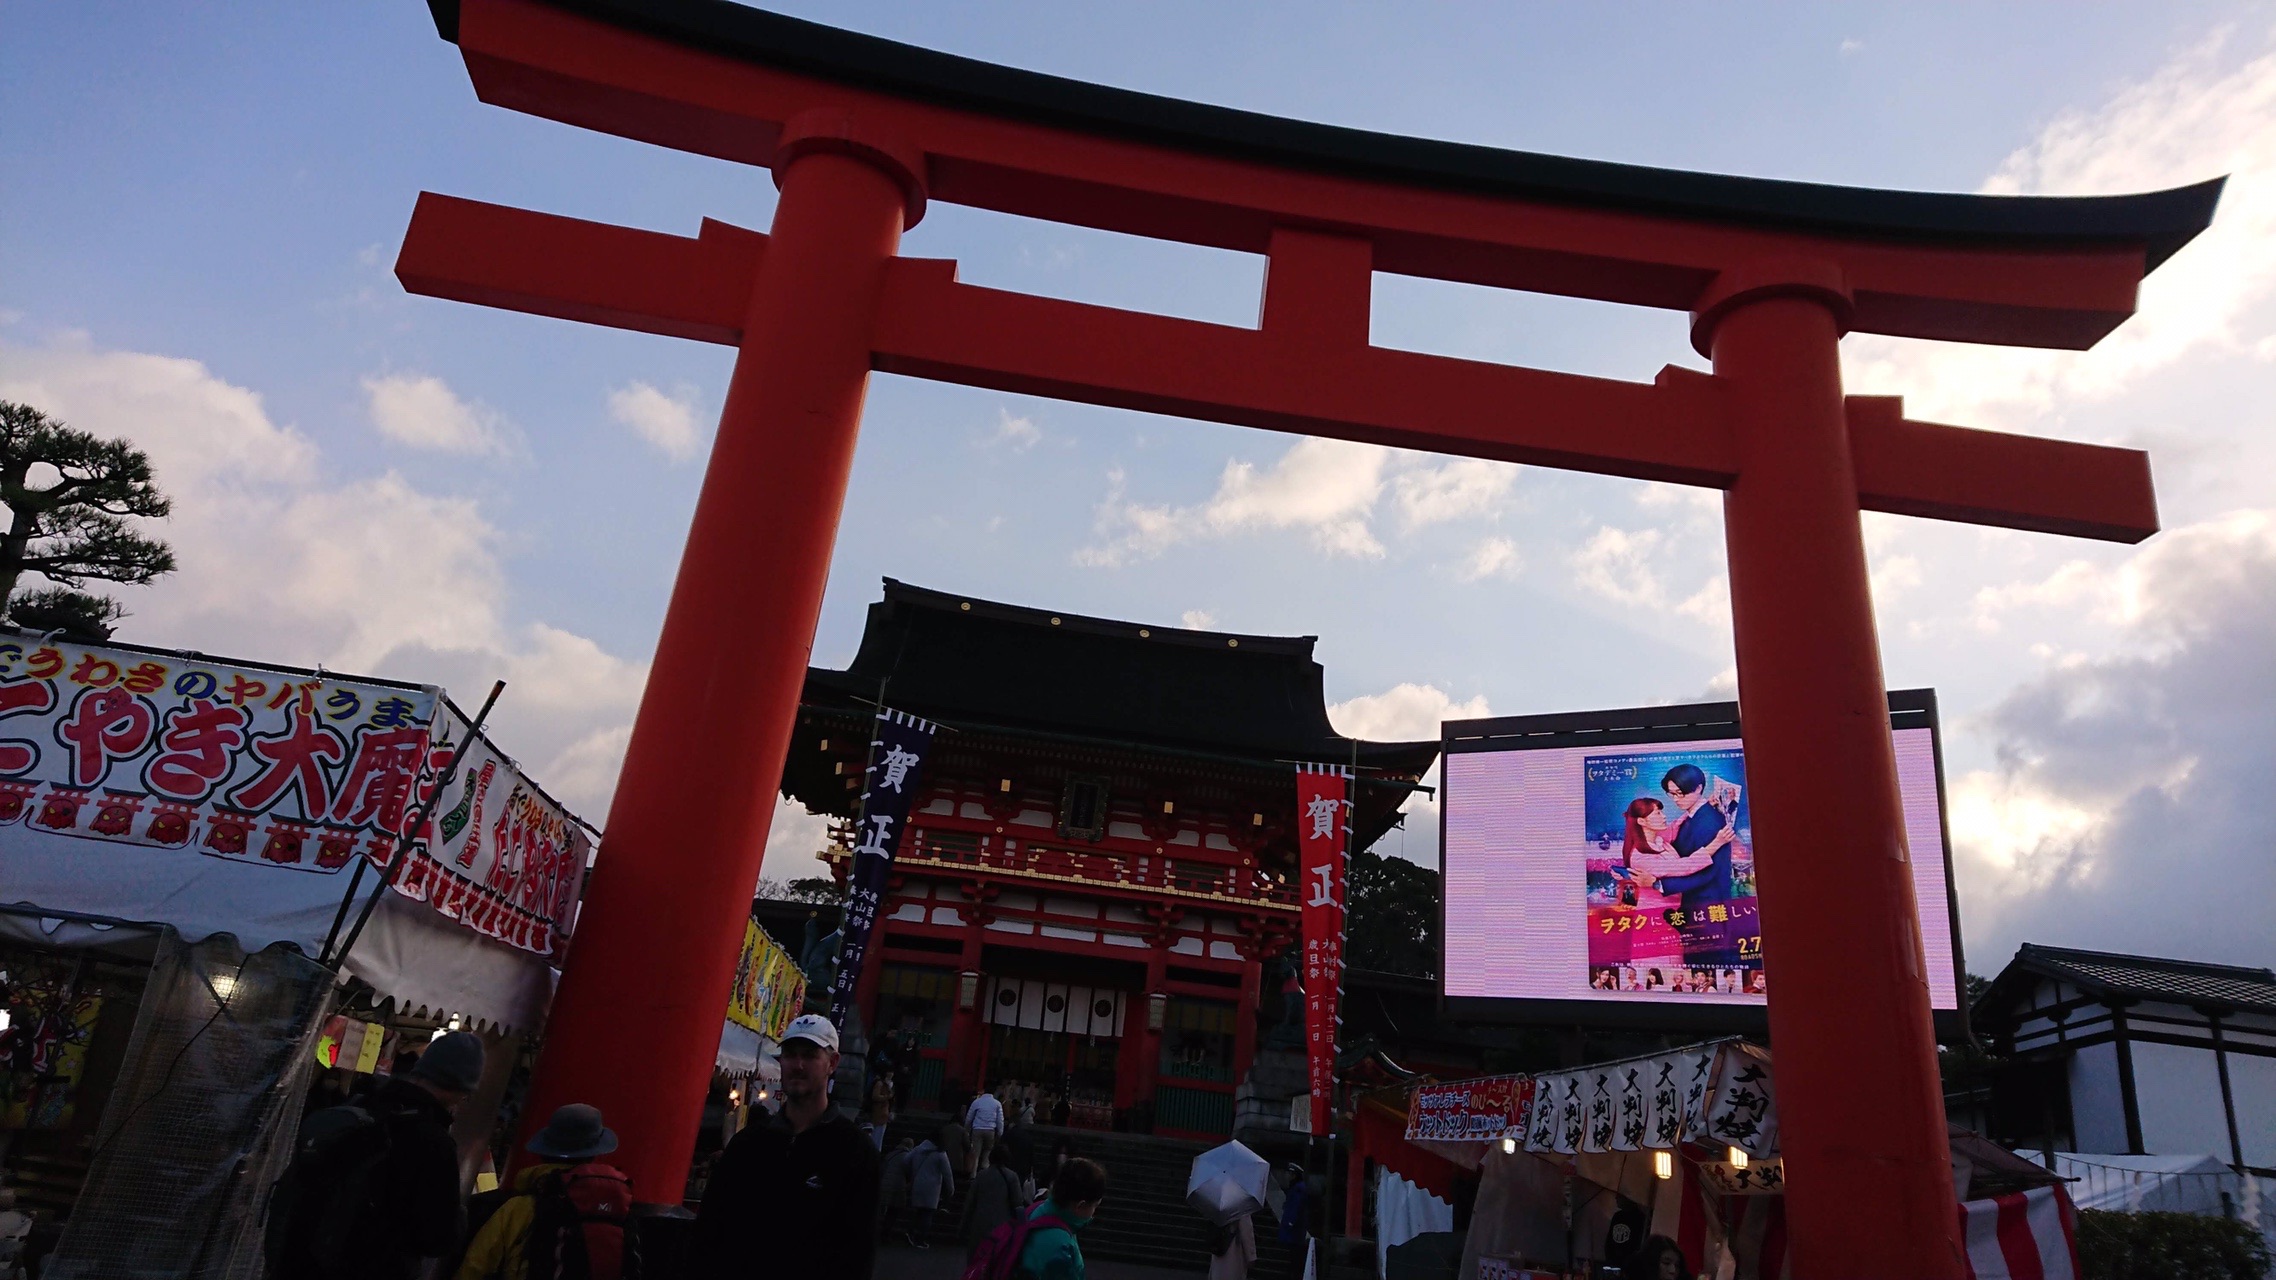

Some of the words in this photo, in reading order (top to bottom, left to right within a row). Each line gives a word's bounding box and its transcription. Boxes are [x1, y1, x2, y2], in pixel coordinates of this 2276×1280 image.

[857, 744, 919, 860] 賀正
[1304, 794, 1338, 908] 賀正
[1600, 904, 1756, 934] ヲタクに恋は難しい
[1737, 936, 1761, 954] 2.7
[1531, 1081, 1553, 1148] 大判焼
[1564, 1078, 1584, 1150] 大判焼
[1592, 1074, 1613, 1149] 大判焼
[1622, 1068, 1645, 1146] 大判焼
[1655, 1062, 1679, 1142] 大判焼
[1714, 1063, 1770, 1150] 大判焼
